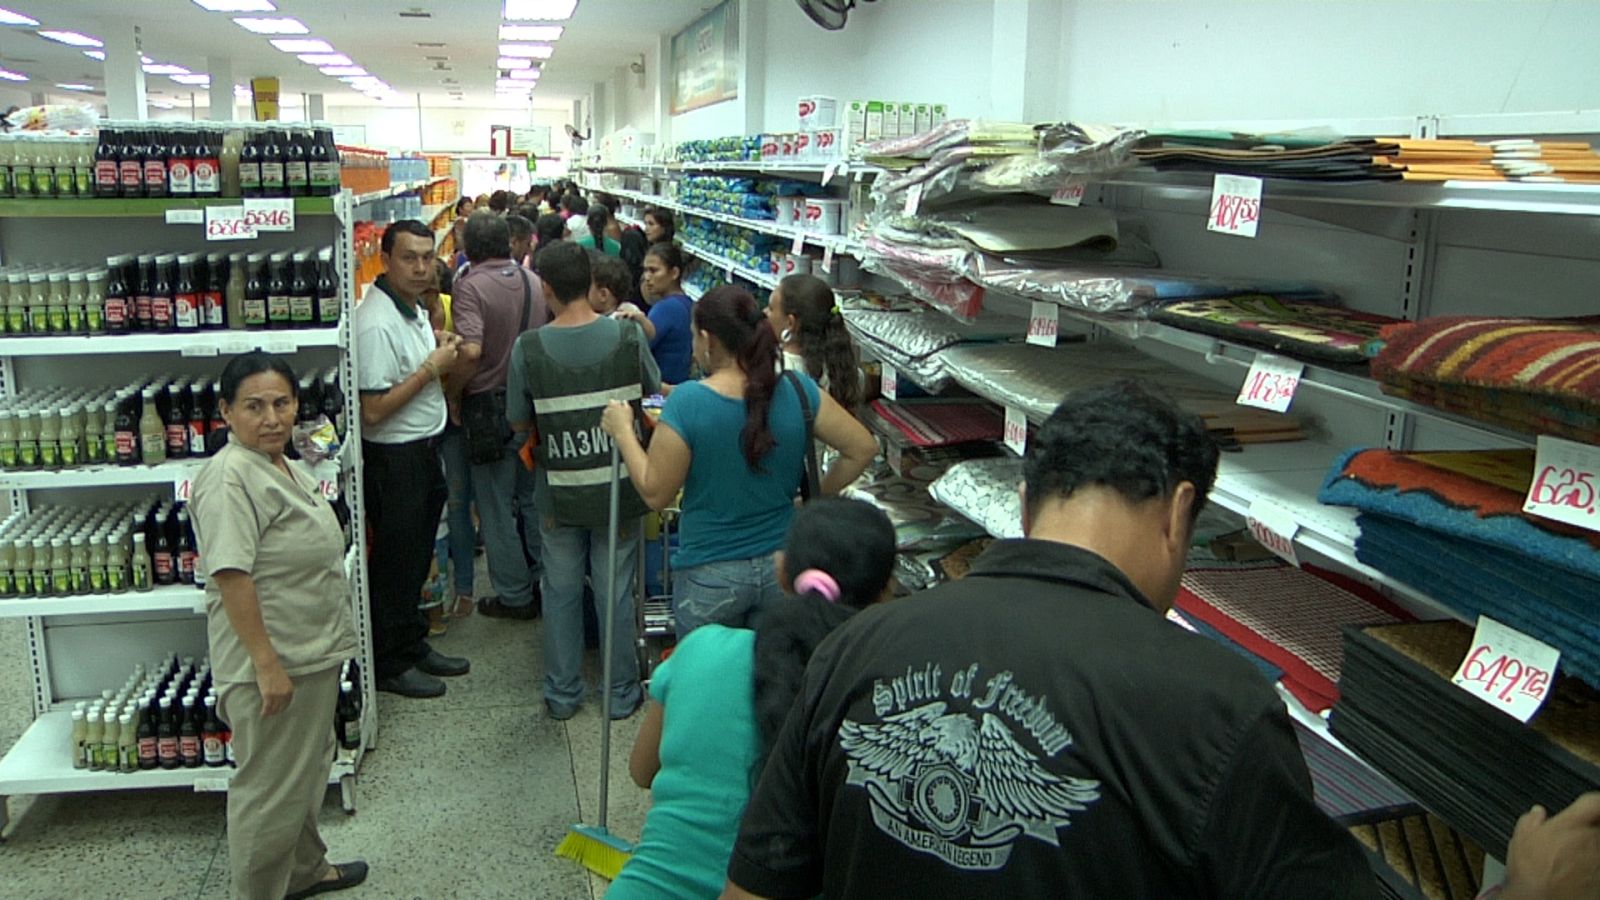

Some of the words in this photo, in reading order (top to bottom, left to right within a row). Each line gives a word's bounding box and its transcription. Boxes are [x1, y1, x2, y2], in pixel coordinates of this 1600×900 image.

[547, 426, 615, 458] AA3W
[872, 661, 943, 716] Spirit
[950, 662, 979, 699] of
[954, 846, 992, 867] LEGEND
